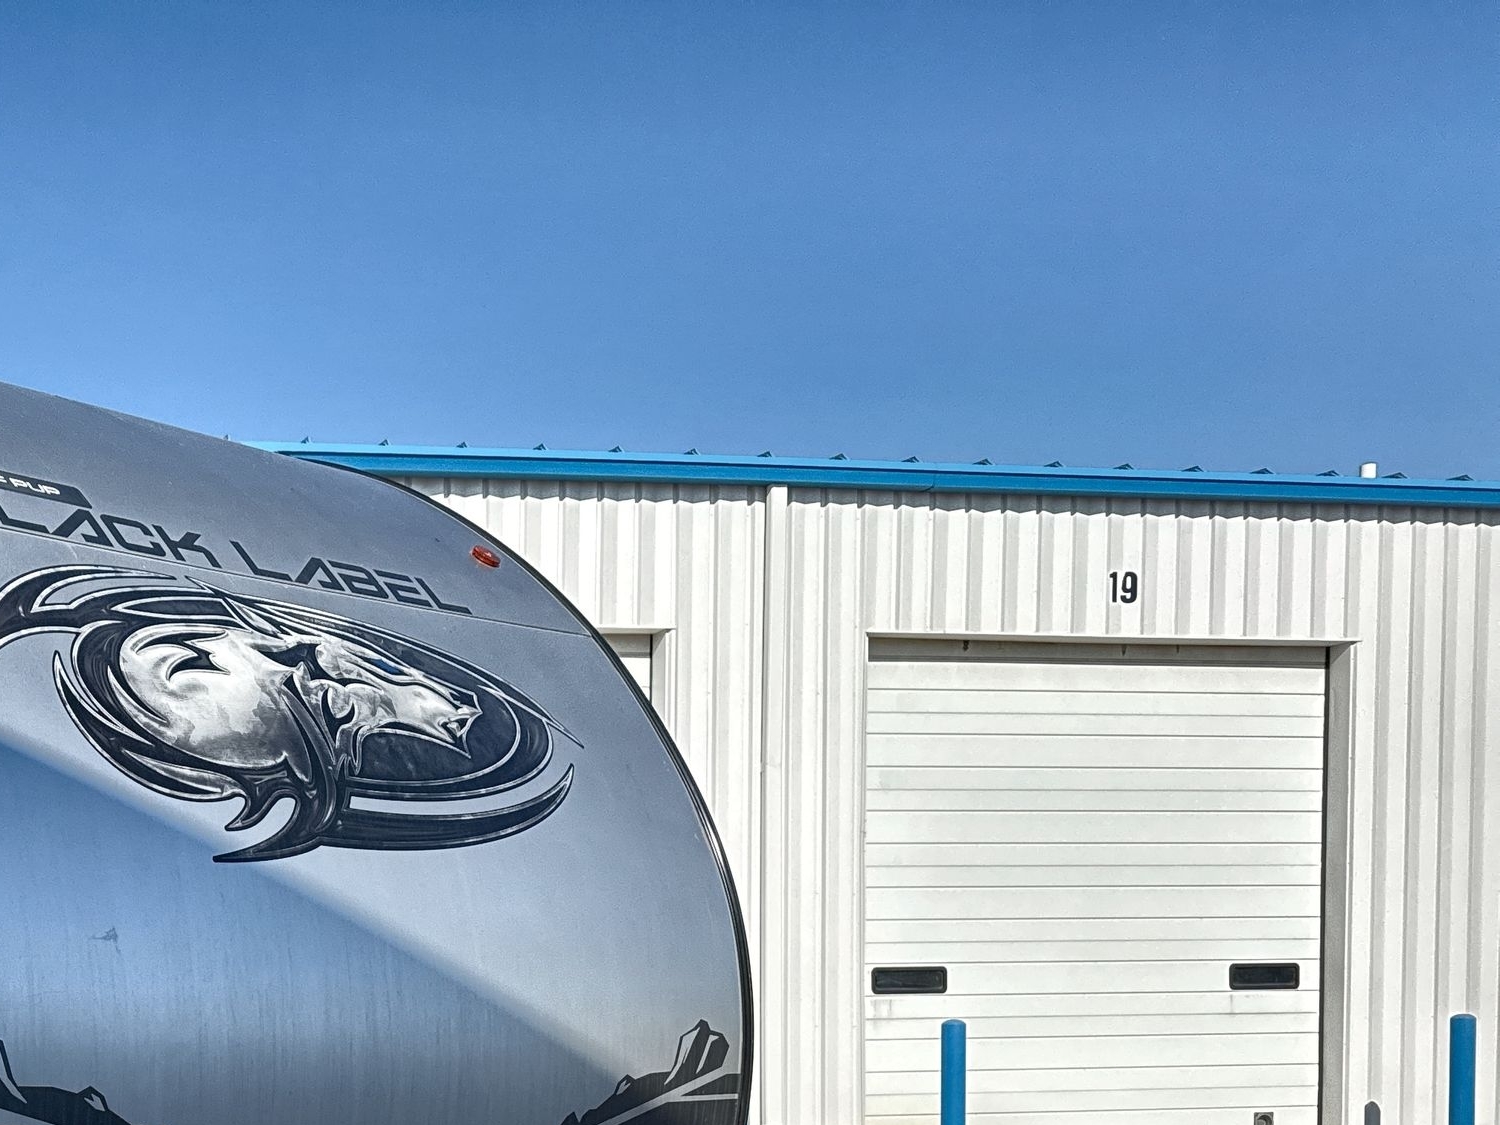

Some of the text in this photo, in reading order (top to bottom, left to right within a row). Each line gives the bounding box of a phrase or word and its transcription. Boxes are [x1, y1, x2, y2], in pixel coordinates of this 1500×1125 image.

[9, 477, 61, 495] PUP
[229, 539, 473, 615] LABEL
[1109, 571, 1138, 604] 19
